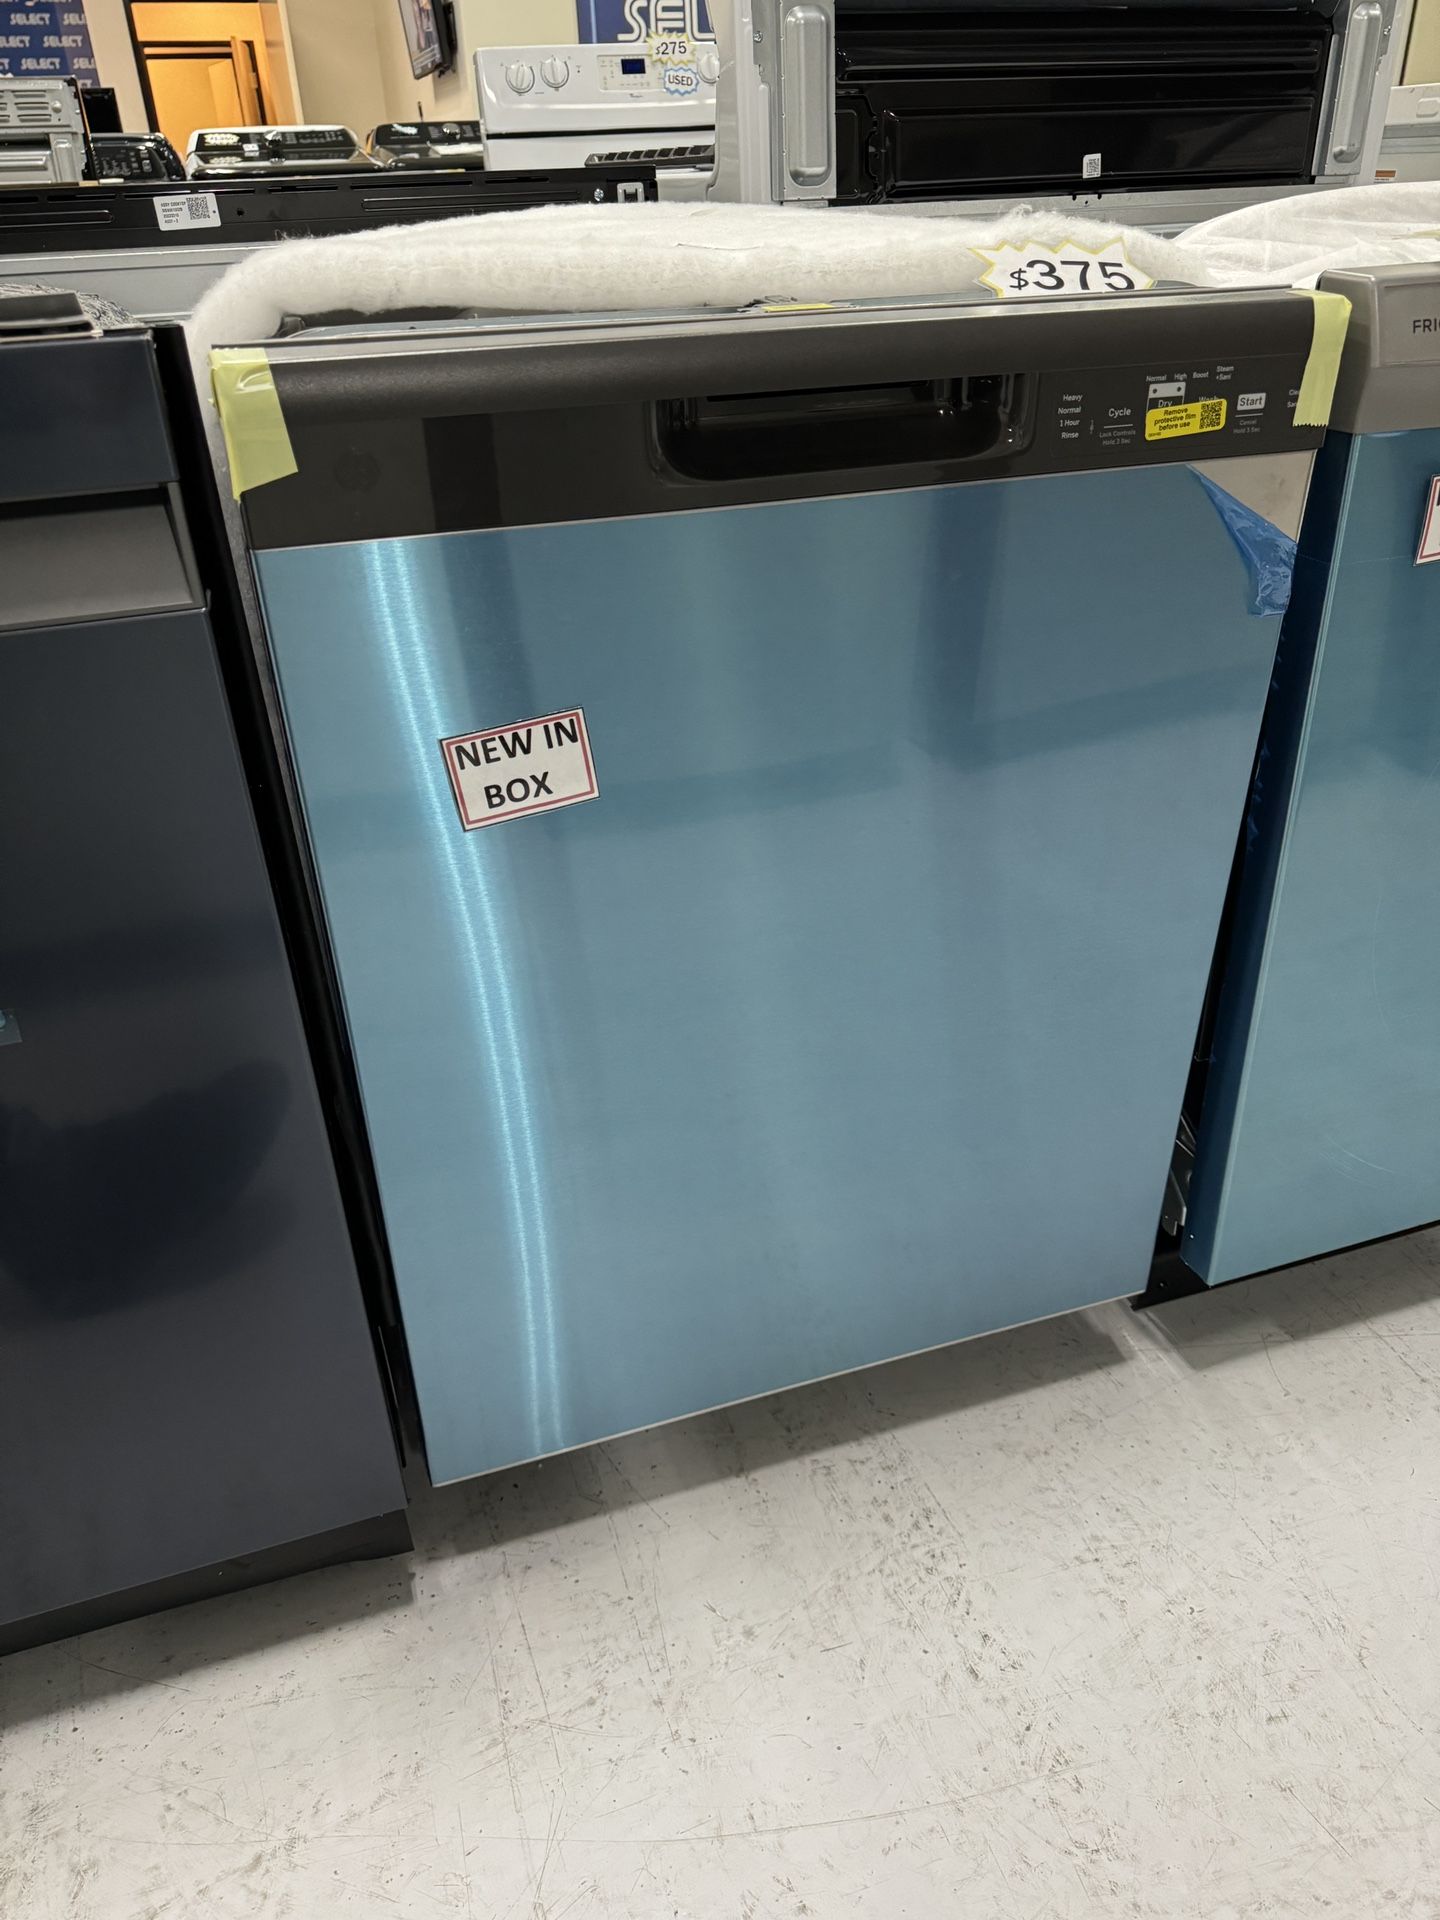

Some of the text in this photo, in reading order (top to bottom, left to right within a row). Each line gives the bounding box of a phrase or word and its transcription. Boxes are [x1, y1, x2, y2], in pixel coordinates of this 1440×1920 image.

[10, 13, 50, 25] SELECT
[43, 35, 82, 48] SELECT
[655, 41, 687, 56] $275
[21, 57, 60, 70] SELECT
[668, 74, 693, 86] USED
[1010, 260, 1135, 290] $375
[1413, 318, 1440, 333] FRI
[1217, 365, 1234, 373] Steam
[1146, 371, 1209, 382] Normal High Boost
[1063, 394, 1083, 402] Heavy
[1158, 399, 1172, 407] Dry
[1239, 396, 1262, 407] Start
[1058, 406, 1082, 415] Normal
[1108, 408, 1132, 418] Cycle
[1163, 407, 1188, 417] Remove
[1064, 419, 1080, 427] Hour
[1154, 412, 1196, 426] protective film
[1158, 420, 1191, 431] before use
[454, 718, 579, 770] NEW IN
[484, 771, 553, 809] BOX
